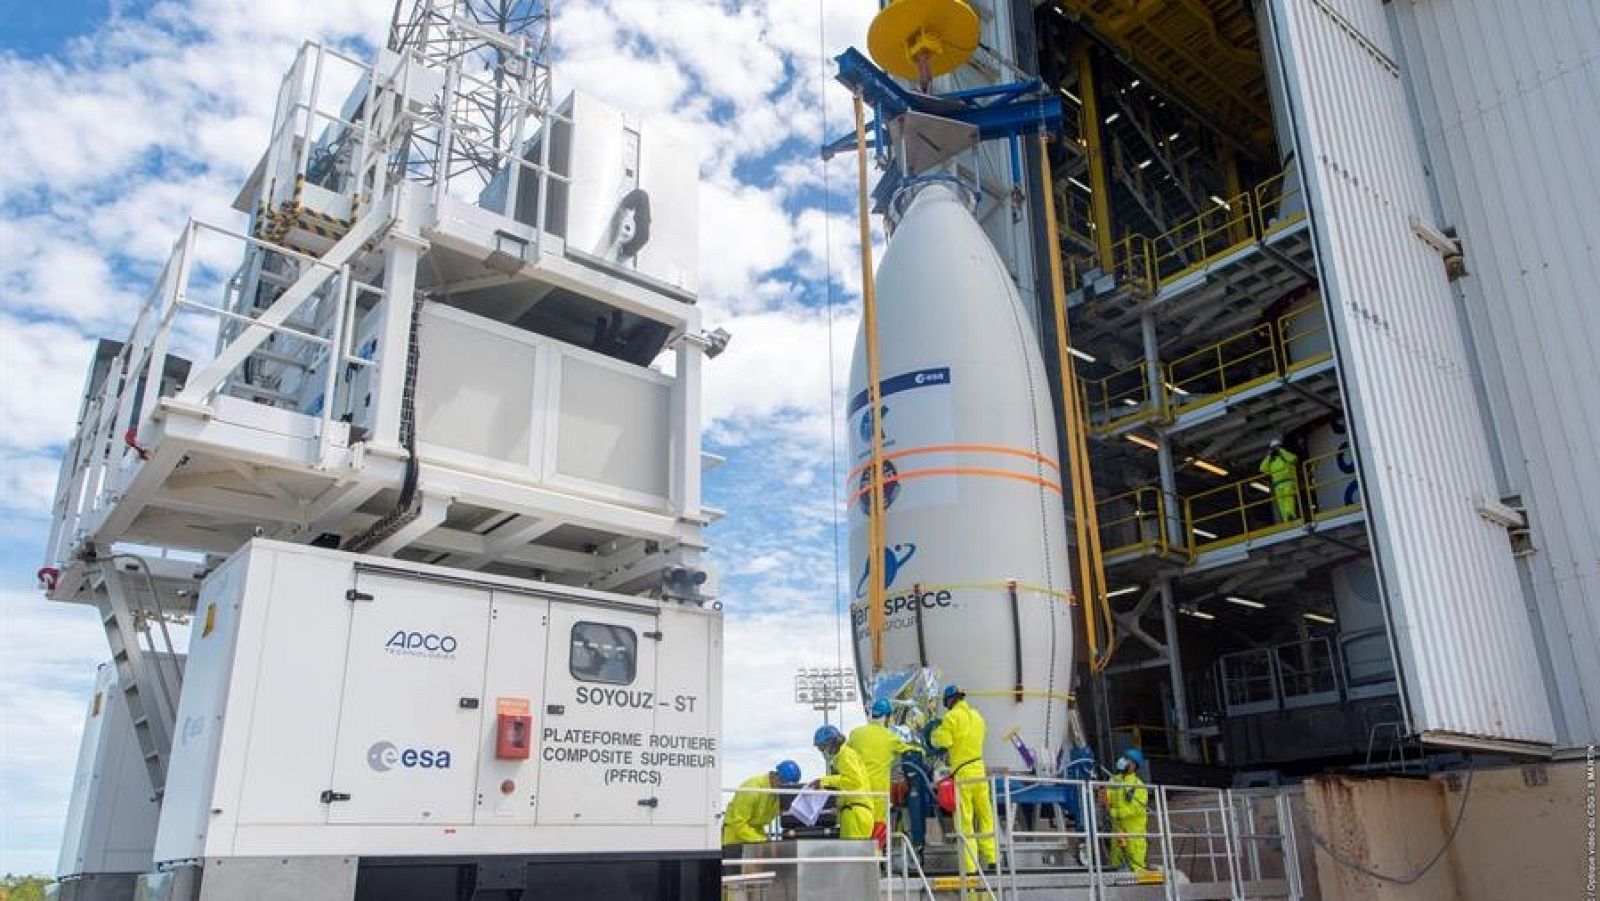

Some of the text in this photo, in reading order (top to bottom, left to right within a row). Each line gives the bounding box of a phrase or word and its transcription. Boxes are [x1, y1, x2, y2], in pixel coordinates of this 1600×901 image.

[386, 631, 456, 653] APCO
[576, 686, 653, 709] SOYOUZ
[675, 696, 697, 712] ST
[543, 728, 716, 751] PLATEFORME ROUTIERE
[401, 748, 451, 769] esa
[543, 747, 715, 768] COMPOSITE SUPERIEUR
[604, 769, 662, 786] (PFRCS)
